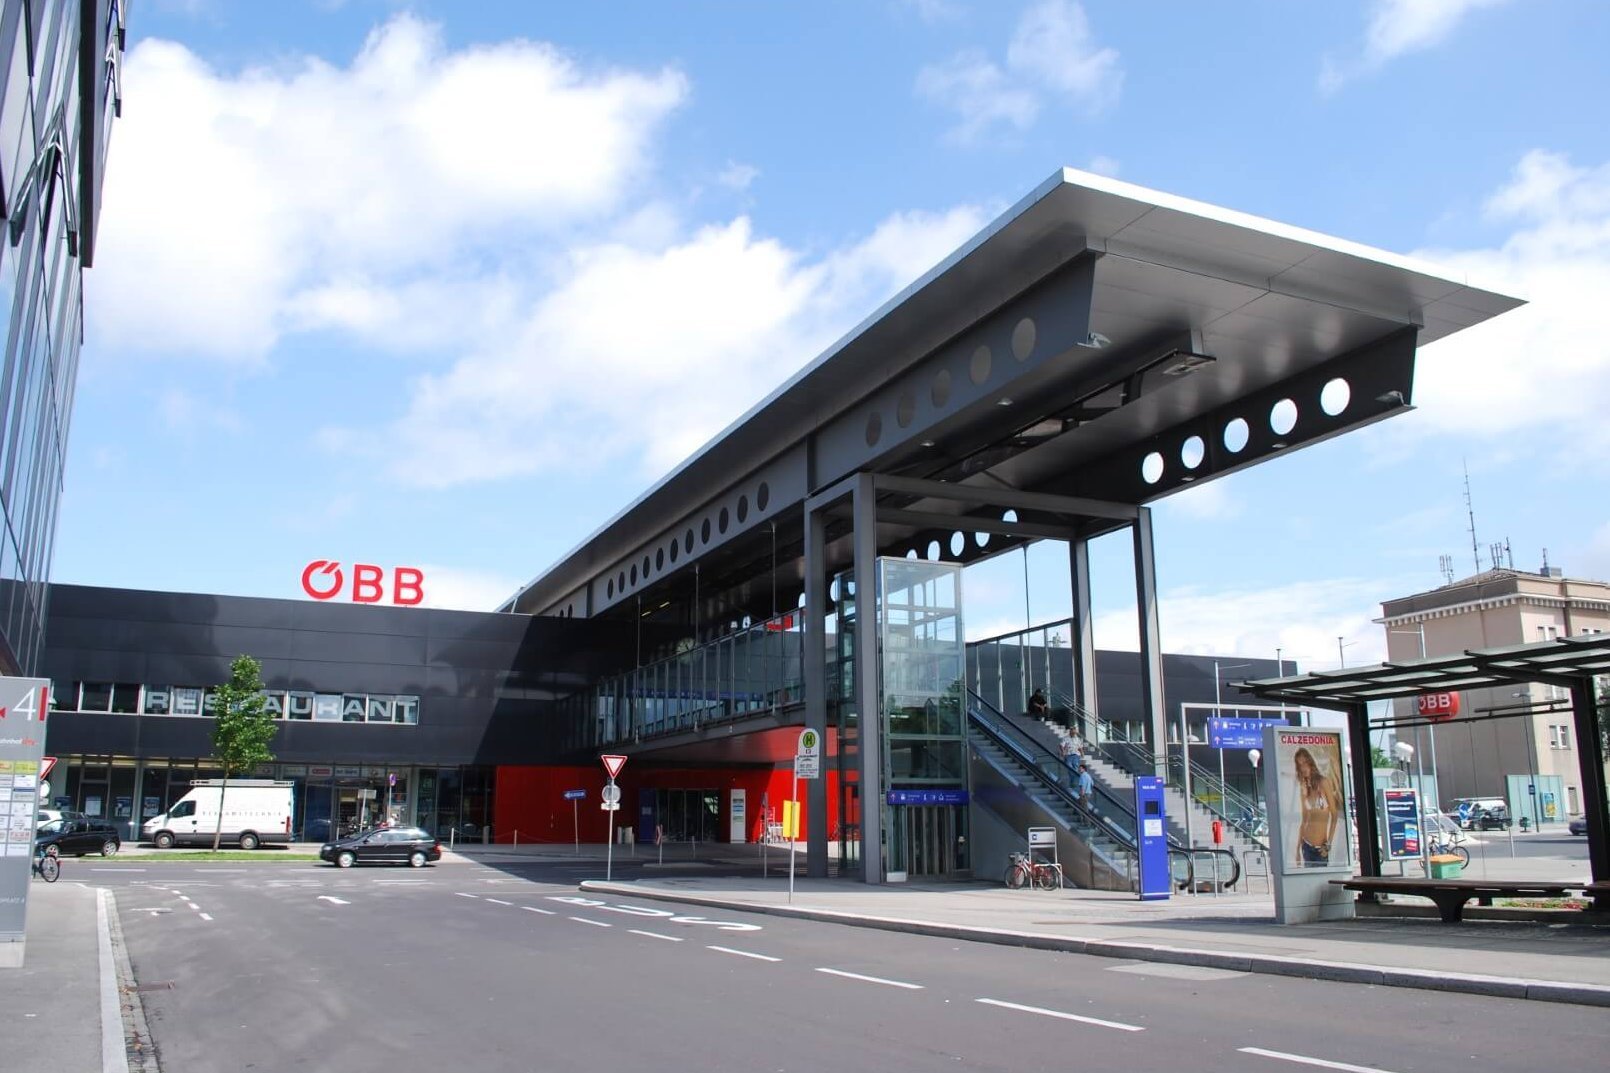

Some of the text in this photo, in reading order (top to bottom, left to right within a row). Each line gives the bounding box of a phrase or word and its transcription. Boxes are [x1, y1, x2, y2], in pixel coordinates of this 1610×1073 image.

[302, 560, 424, 606] ÖBB
[12, 687, 37, 721] 4
[1281, 735, 1334, 745] CALZEDONIA
[544, 897, 763, 931] BUS
